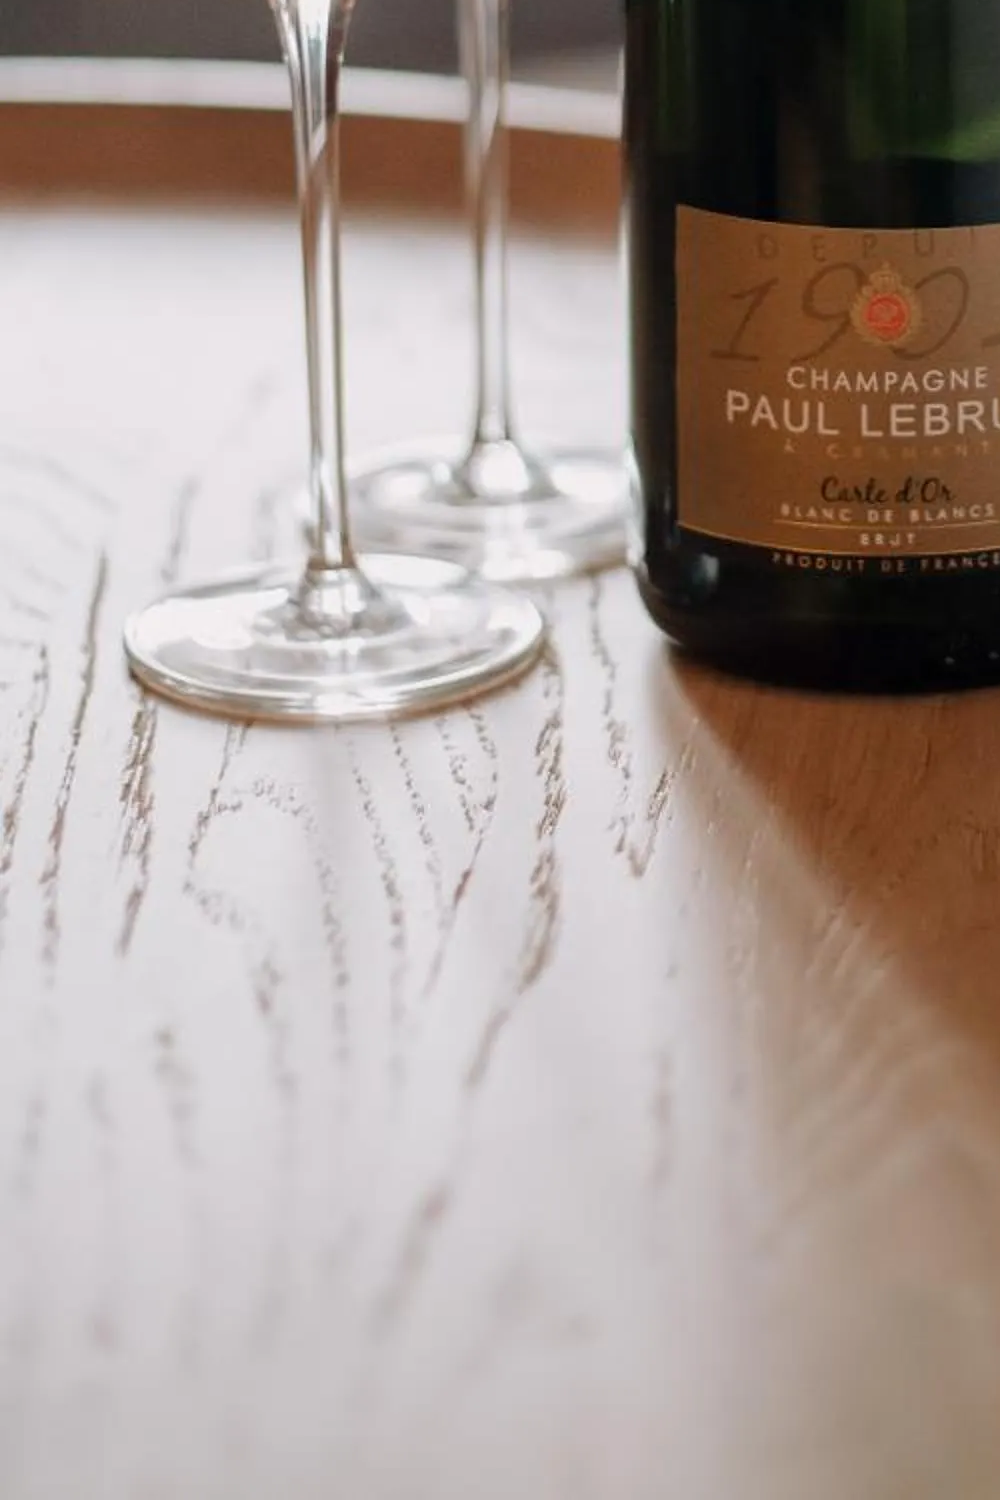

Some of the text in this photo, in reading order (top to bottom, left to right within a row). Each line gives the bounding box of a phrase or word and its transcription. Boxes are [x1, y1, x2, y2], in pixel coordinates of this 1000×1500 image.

[786, 366, 990, 393] CHAMPAGNE
[727, 390, 840, 437] PAUL
[820, 475, 957, 505] Carte d'Or
[779, 502, 997, 524] BLANC DE BLANCS
[859, 532, 917, 548] BRUT
[771, 552, 866, 573] PRODUIT
[880, 558, 907, 574] DE
